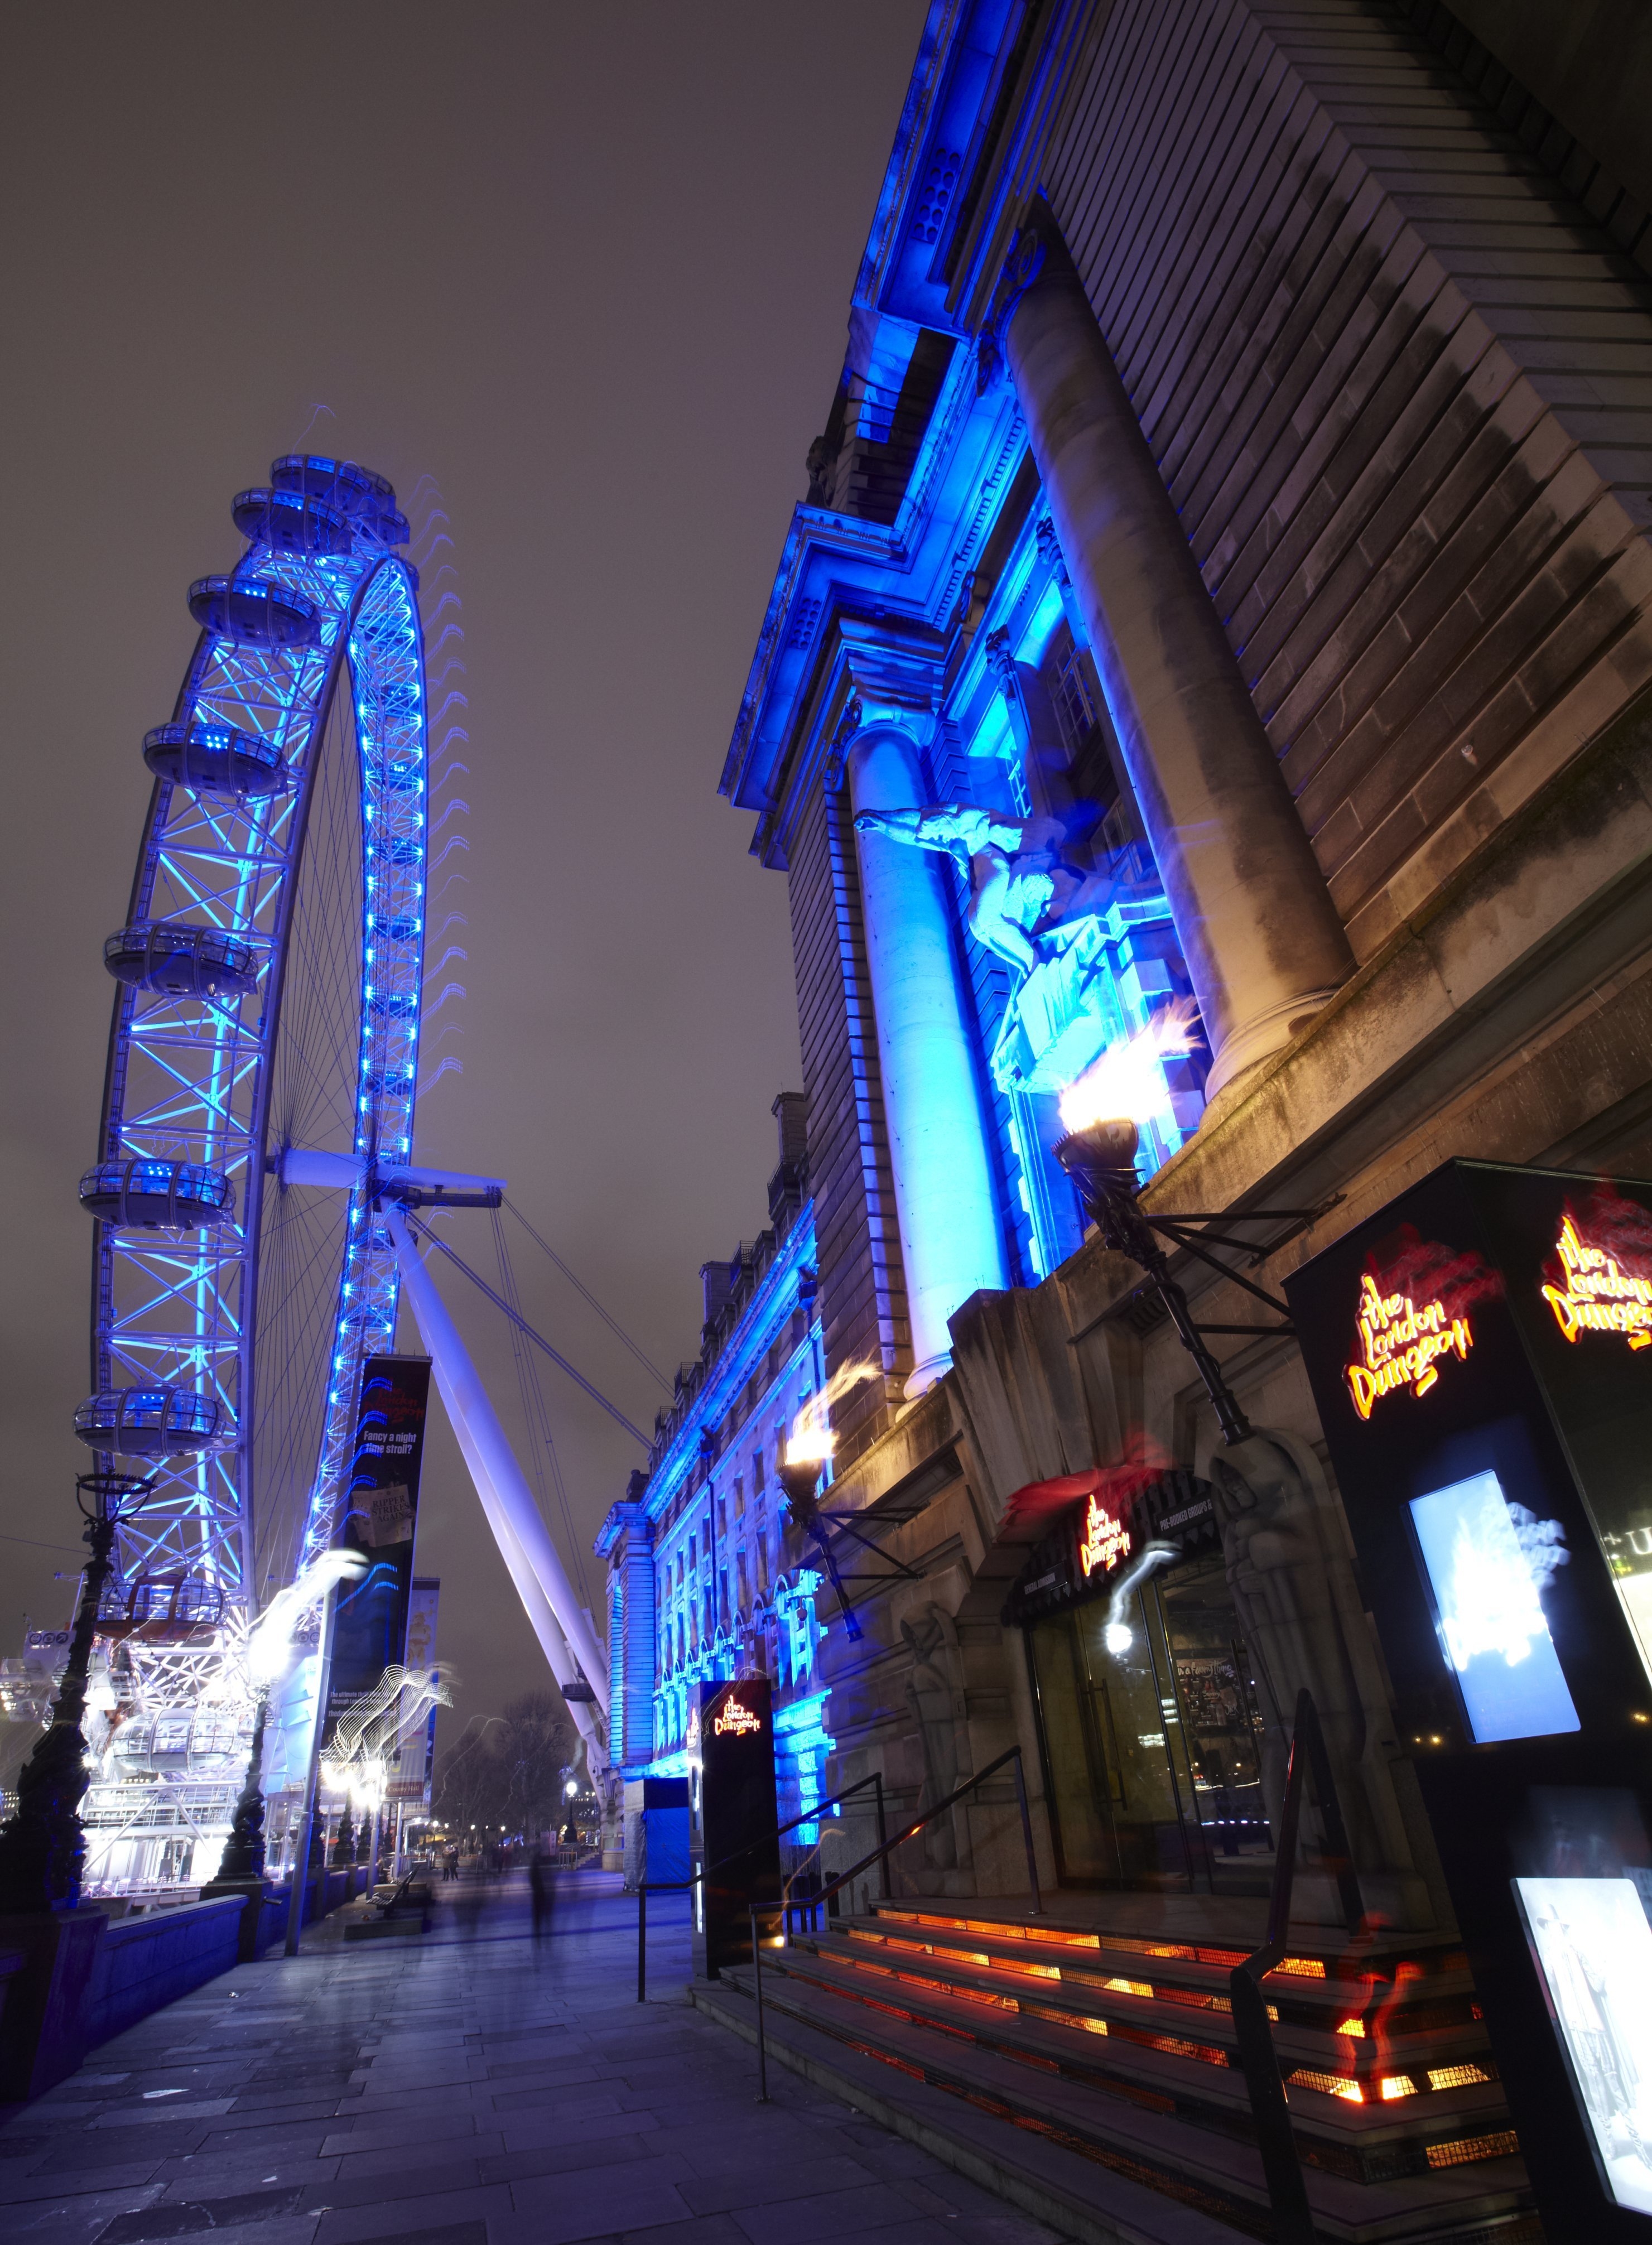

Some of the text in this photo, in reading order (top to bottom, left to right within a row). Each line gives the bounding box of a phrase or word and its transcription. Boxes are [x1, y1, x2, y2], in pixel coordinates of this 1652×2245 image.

[1557, 1216, 1607, 1273] the
[1557, 1249, 1652, 1305] London
[1360, 1274, 1404, 1329] the
[1358, 1298, 1447, 1370] London
[1346, 1318, 1474, 1420] Dungeon
[363, 1430, 388, 1443] Fancy
[395, 1432, 417, 1443] night
[386, 1444, 413, 1454] stroll?
[372, 1495, 406, 1508] RIPPER
[372, 1502, 410, 1516] STRIKES
[377, 1511, 404, 1523] AGAIN
[1087, 1495, 1106, 1528] the
[1159, 1499, 1213, 1531] PRE-BOOKED GROUPS &
[1087, 1513, 1121, 1549] London
[1081, 1531, 1130, 1577] Dungeon
[723, 1706, 754, 1722] London
[725, 1694, 741, 1713] the
[715, 1718, 760, 1736] Dungeon
